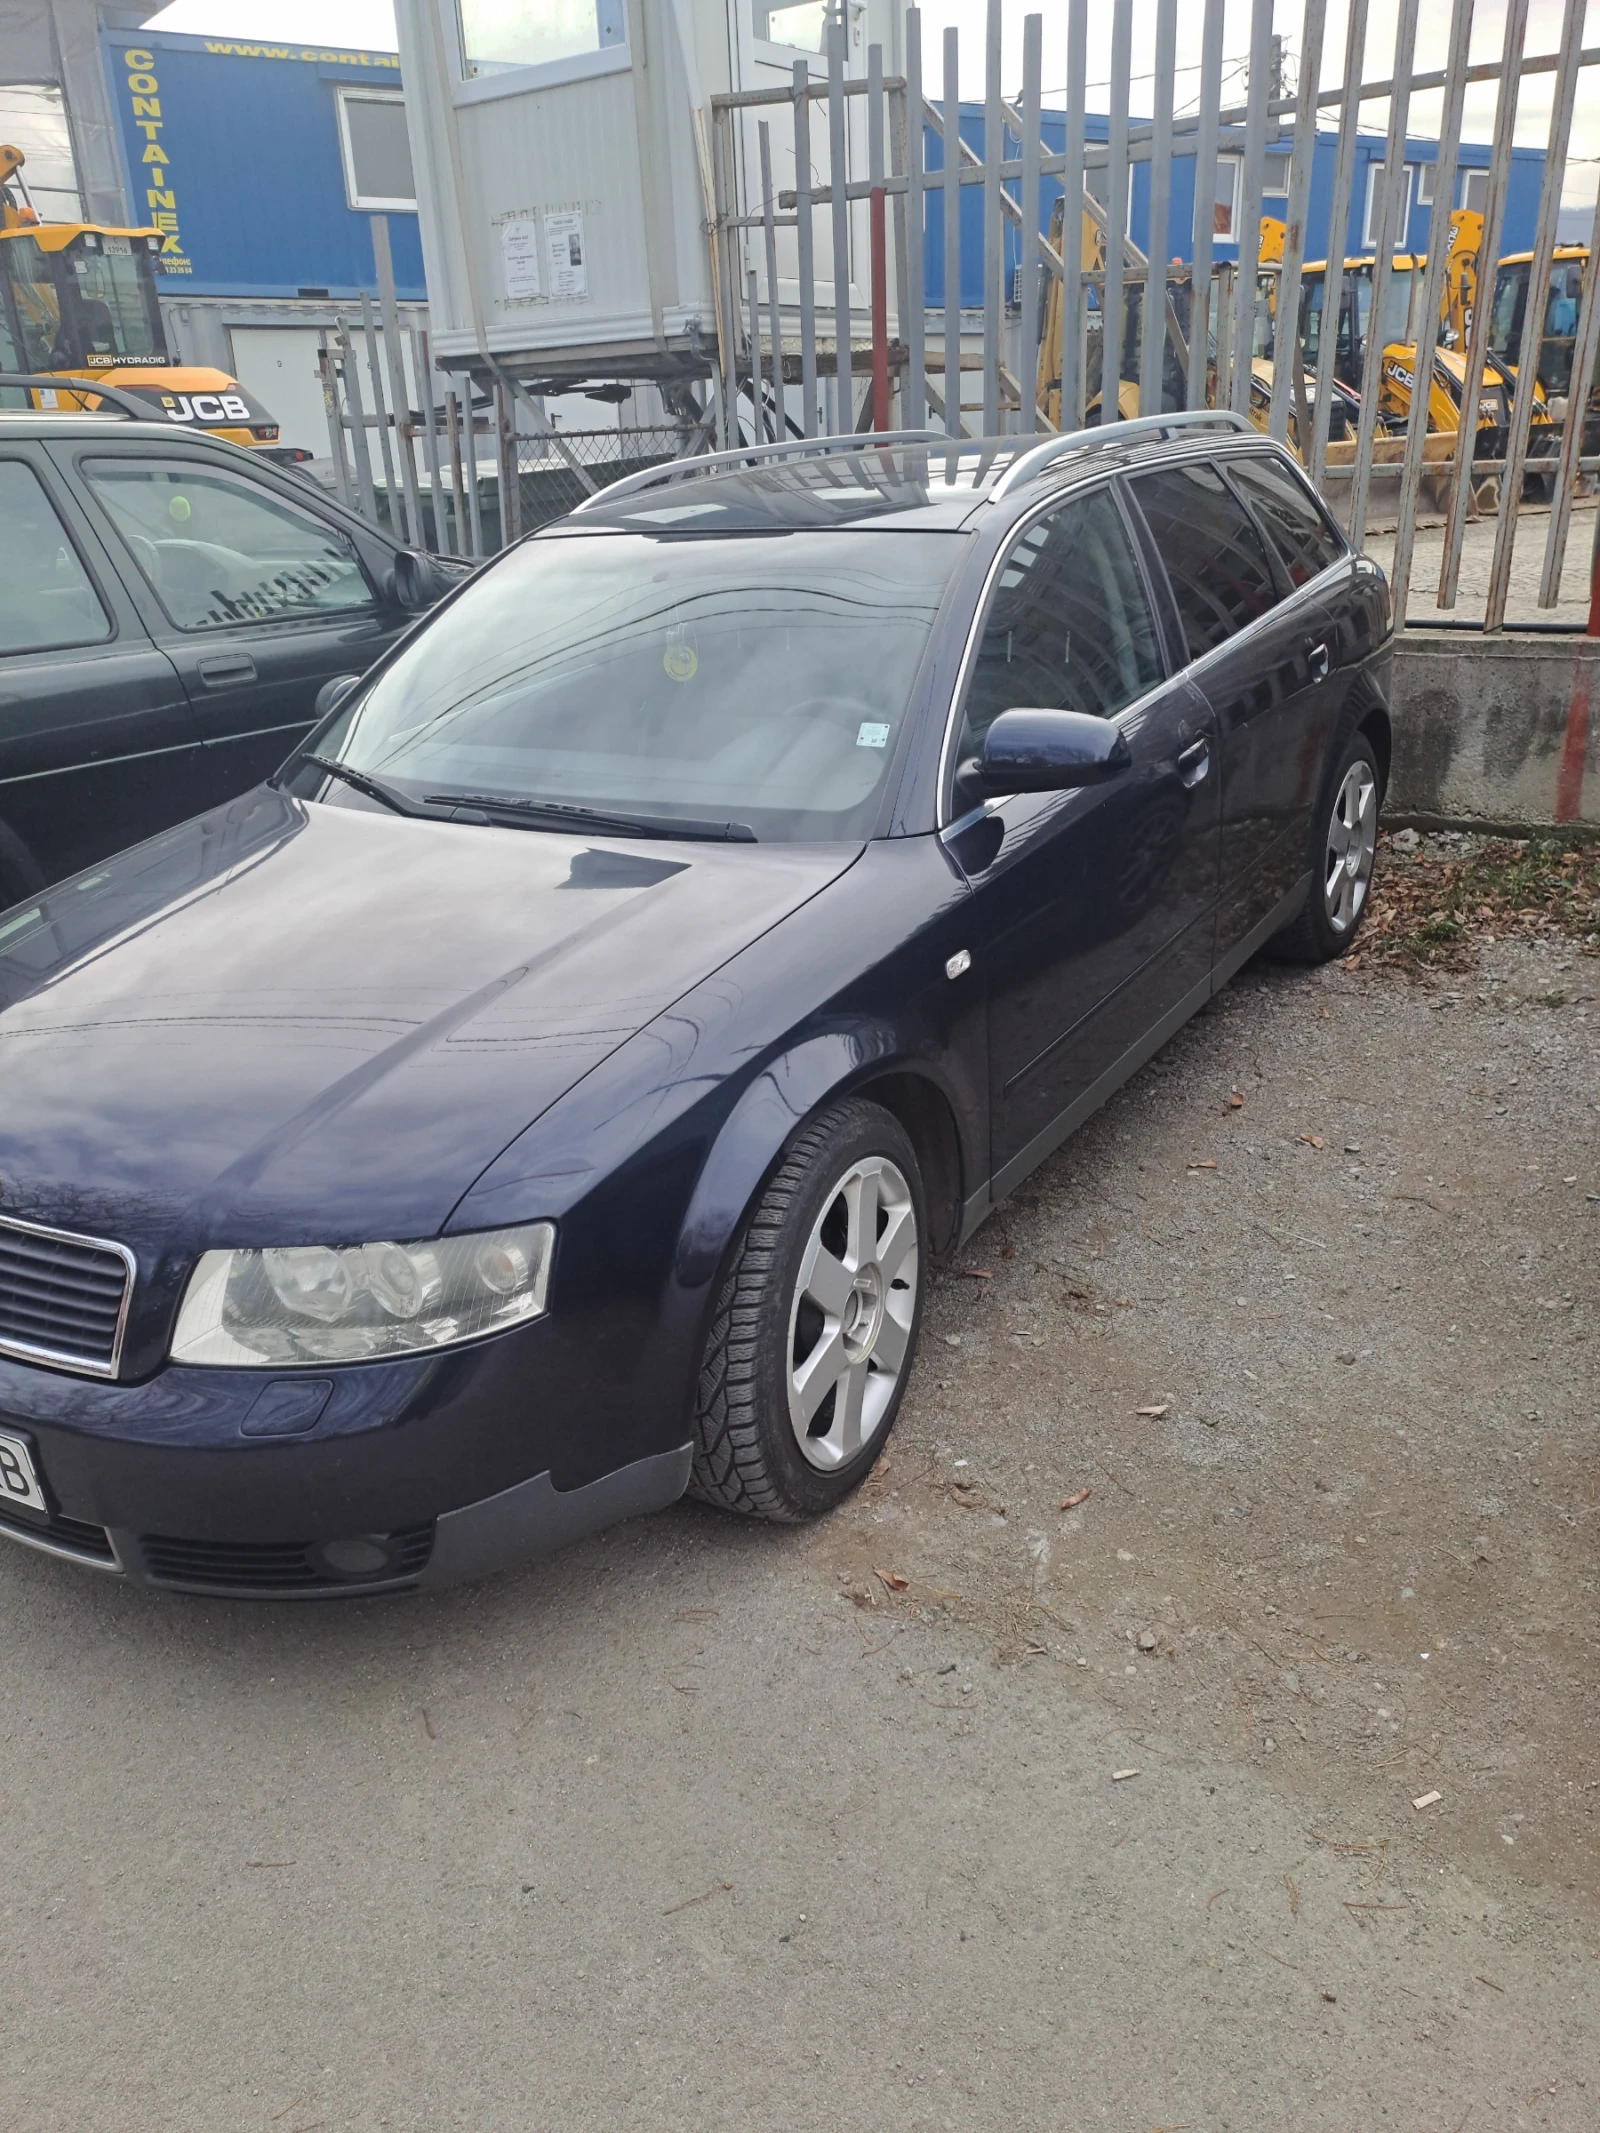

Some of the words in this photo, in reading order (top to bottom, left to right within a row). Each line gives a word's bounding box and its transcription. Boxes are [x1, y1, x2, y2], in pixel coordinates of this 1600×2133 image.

[204, 42, 399, 68] www.contai
[159, 256, 191, 267] лефон:
[90, 357, 111, 365] JCB
[113, 356, 166, 364] HYDRADIG
[166, 395, 251, 422] JCB
[0, 1444, 31, 1497] B
